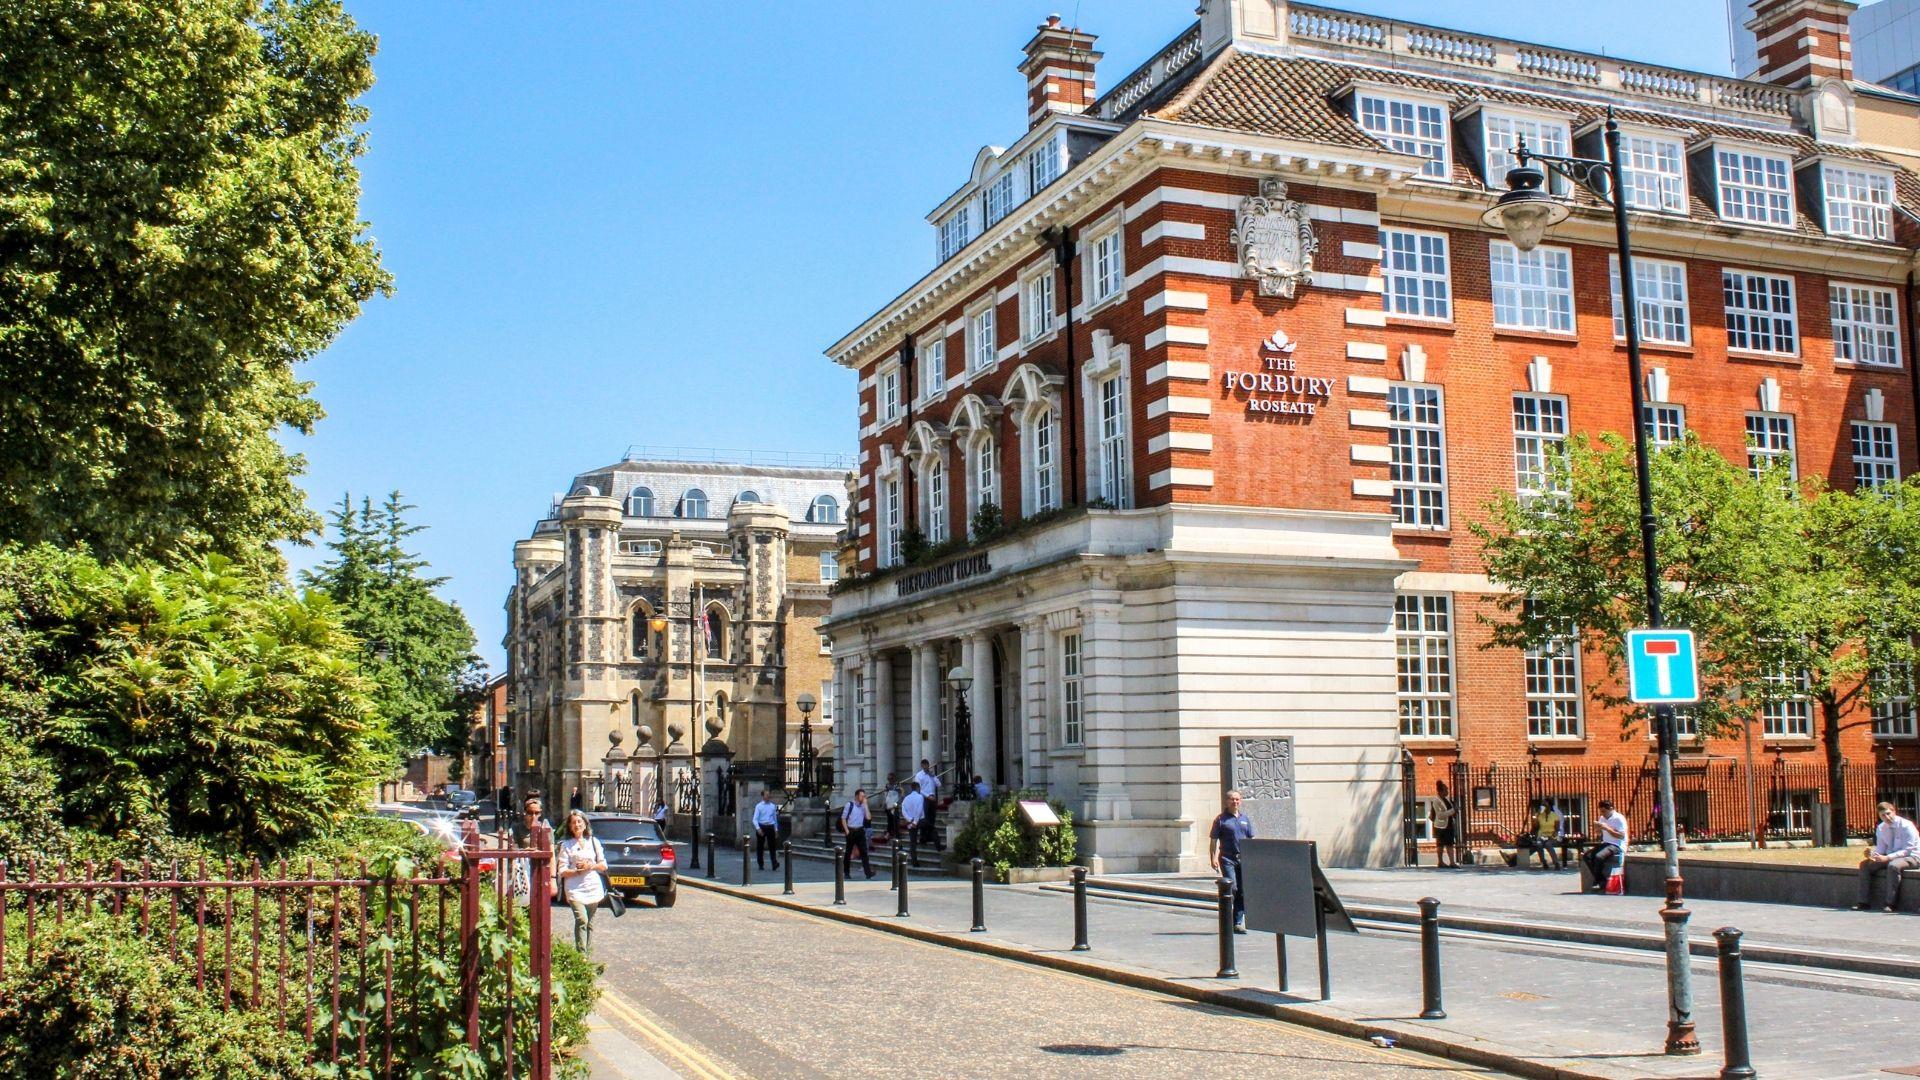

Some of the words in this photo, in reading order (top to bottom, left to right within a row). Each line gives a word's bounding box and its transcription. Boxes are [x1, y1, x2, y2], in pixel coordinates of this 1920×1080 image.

[1266, 358, 1297, 371] THE
[1226, 370, 1336, 396] FORBURY
[1249, 399, 1316, 415] ROSEATE
[895, 576, 914, 596] THE
[914, 563, 954, 591] FORBURY
[956, 551, 992, 579] HOTEL
[1238, 759, 1290, 779] FORBURY
